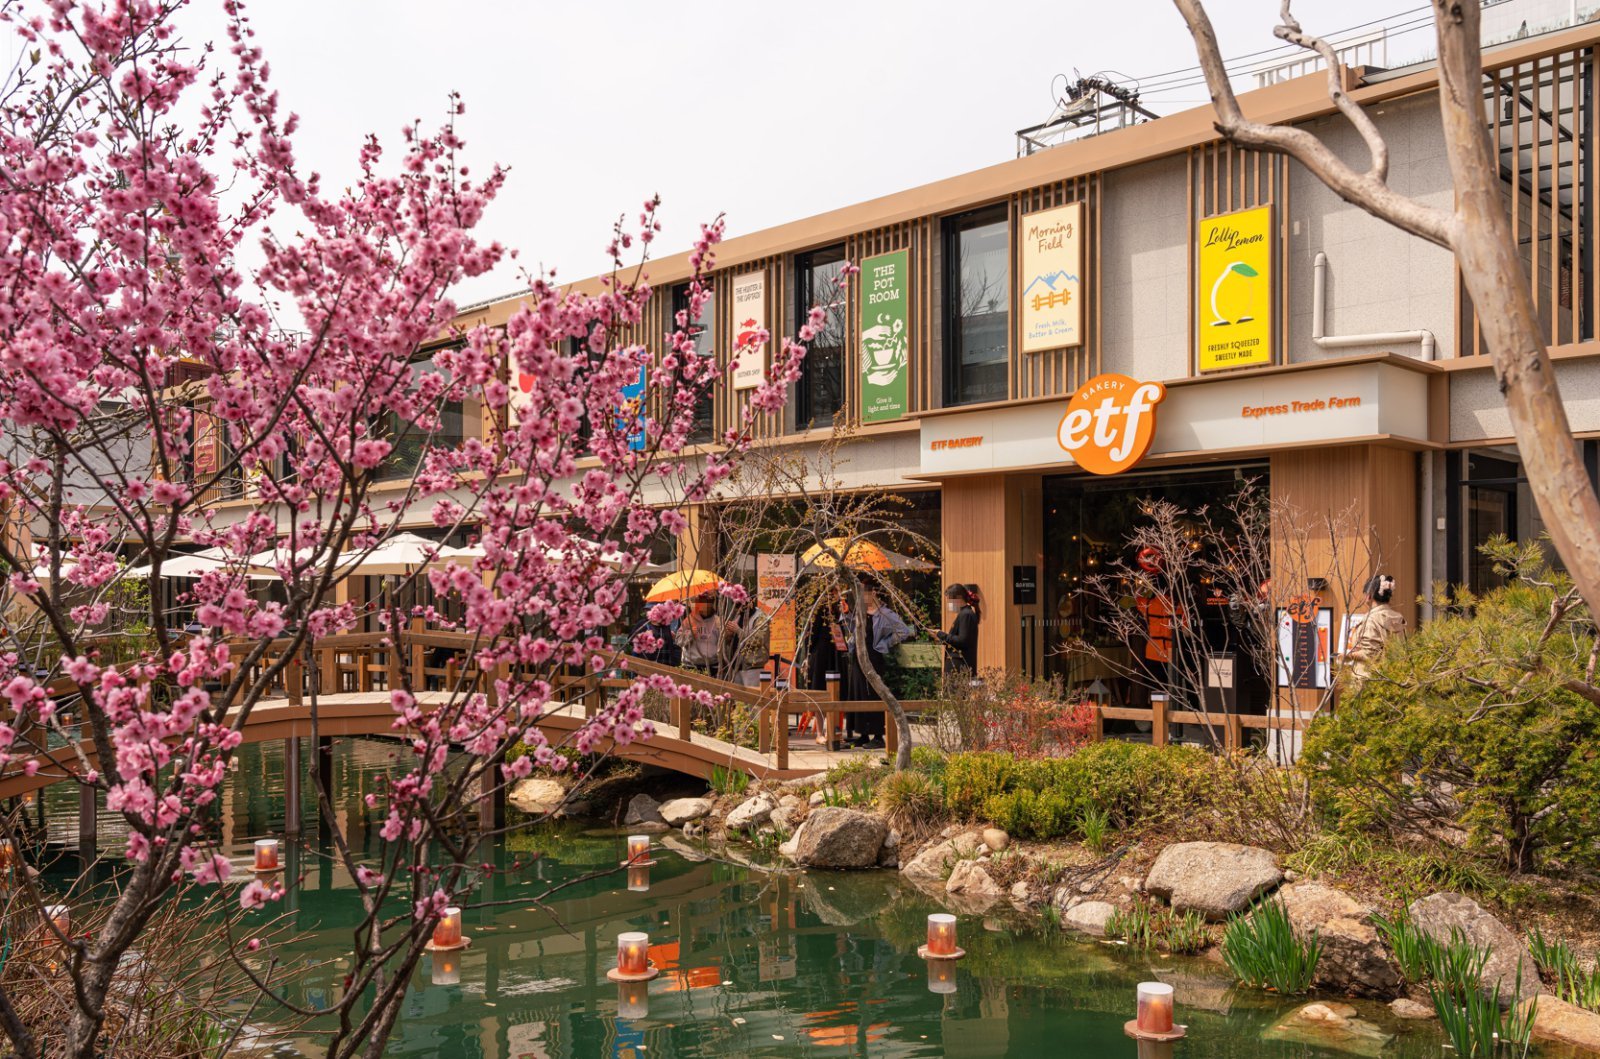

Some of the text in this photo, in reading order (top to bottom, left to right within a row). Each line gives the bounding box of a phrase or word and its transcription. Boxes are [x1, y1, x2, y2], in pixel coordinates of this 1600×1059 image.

[1028, 222, 1072, 241] Morning
[1038, 234, 1063, 253] Field
[1224, 230, 1264, 252] Lemon
[873, 264, 895, 278] THE
[873, 276, 895, 291] POT
[869, 288, 900, 304] ROOM
[1028, 331, 1047, 339] Butter
[1054, 326, 1073, 334] Cream
[1035, 321, 1050, 329] Fresh
[1208, 338, 1260, 352] FRESHLY SQUEEZED
[1215, 349, 1252, 361] SWEETLY MADE
[1081, 380, 1126, 401] BAKERY
[1241, 396, 1361, 419] Express Trade Farm
[1059, 384, 1160, 463] etf
[931, 436, 983, 451] ETF BAKERY
[1287, 597, 1320, 620] etf
